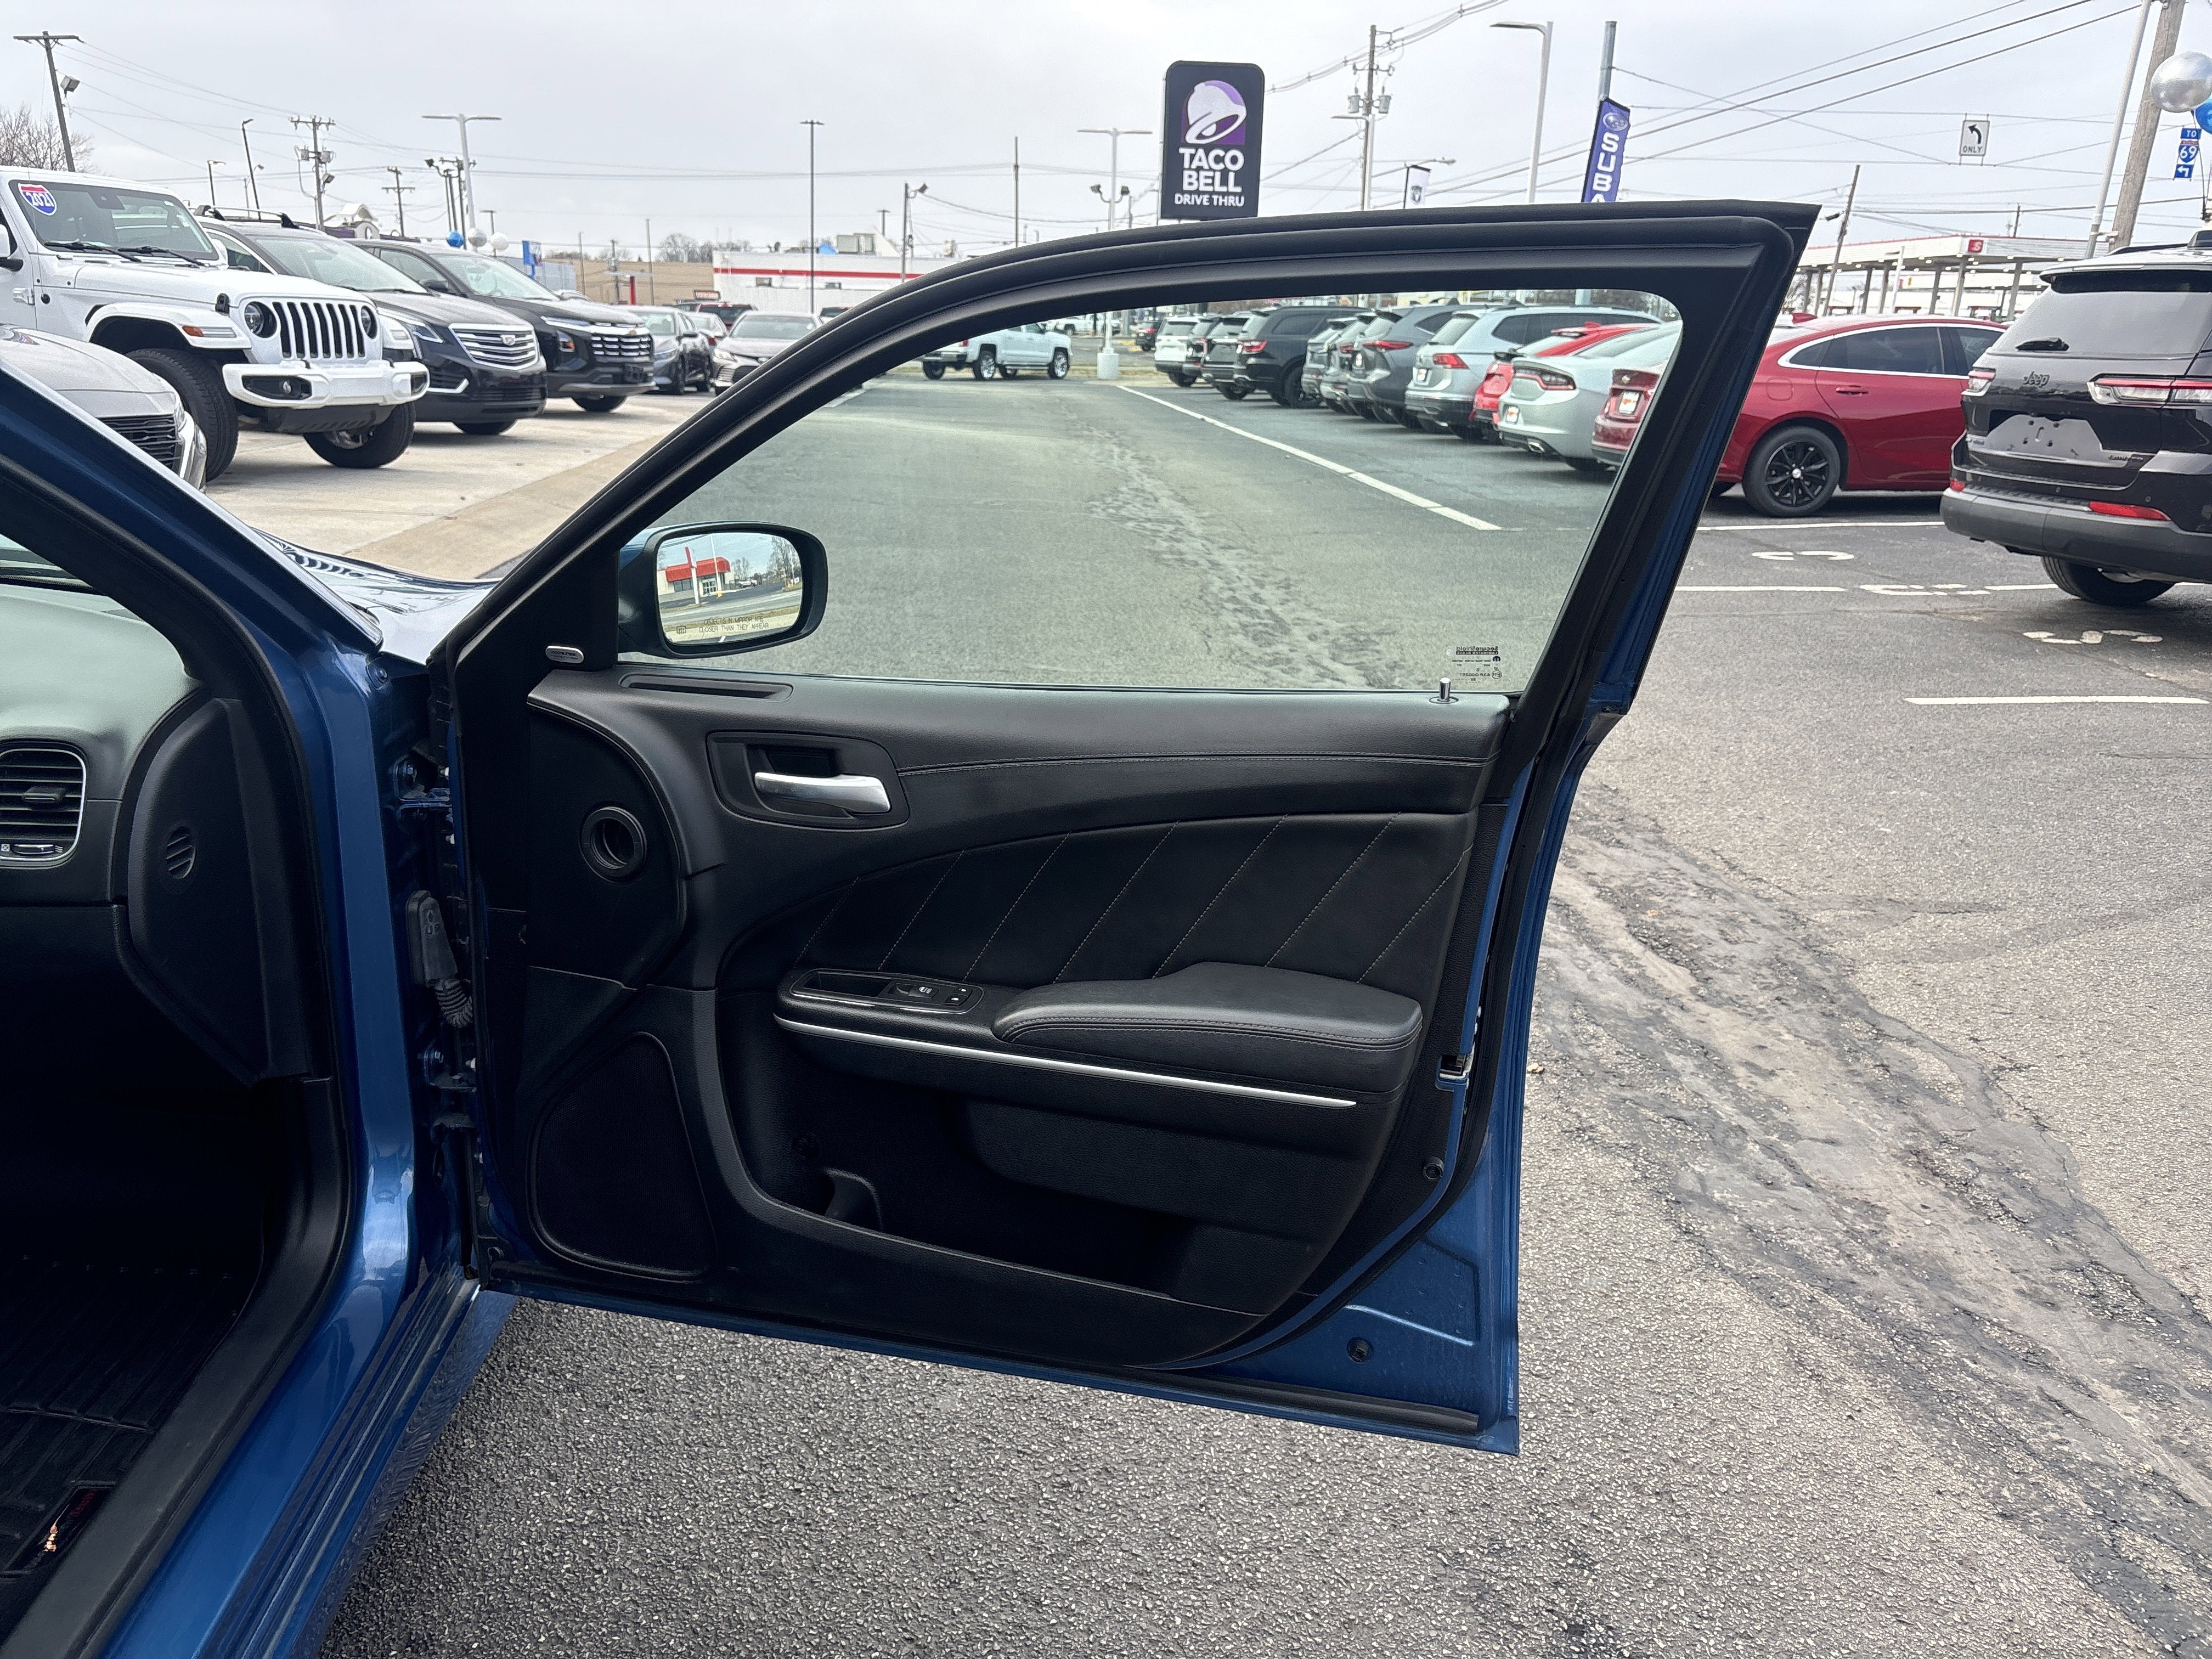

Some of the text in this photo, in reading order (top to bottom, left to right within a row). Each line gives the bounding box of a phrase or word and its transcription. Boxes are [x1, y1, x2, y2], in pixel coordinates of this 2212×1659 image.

[1962, 145, 1983, 153] ONLY
[2180, 145, 2197, 159] 69
[1178, 147, 1245, 171] TACO
[1182, 170, 1243, 193] BELL
[25, 191, 55, 207] 2021
[1174, 193, 1245, 207] DRIVE THRU
[2023, 370, 2050, 388] Jeep
